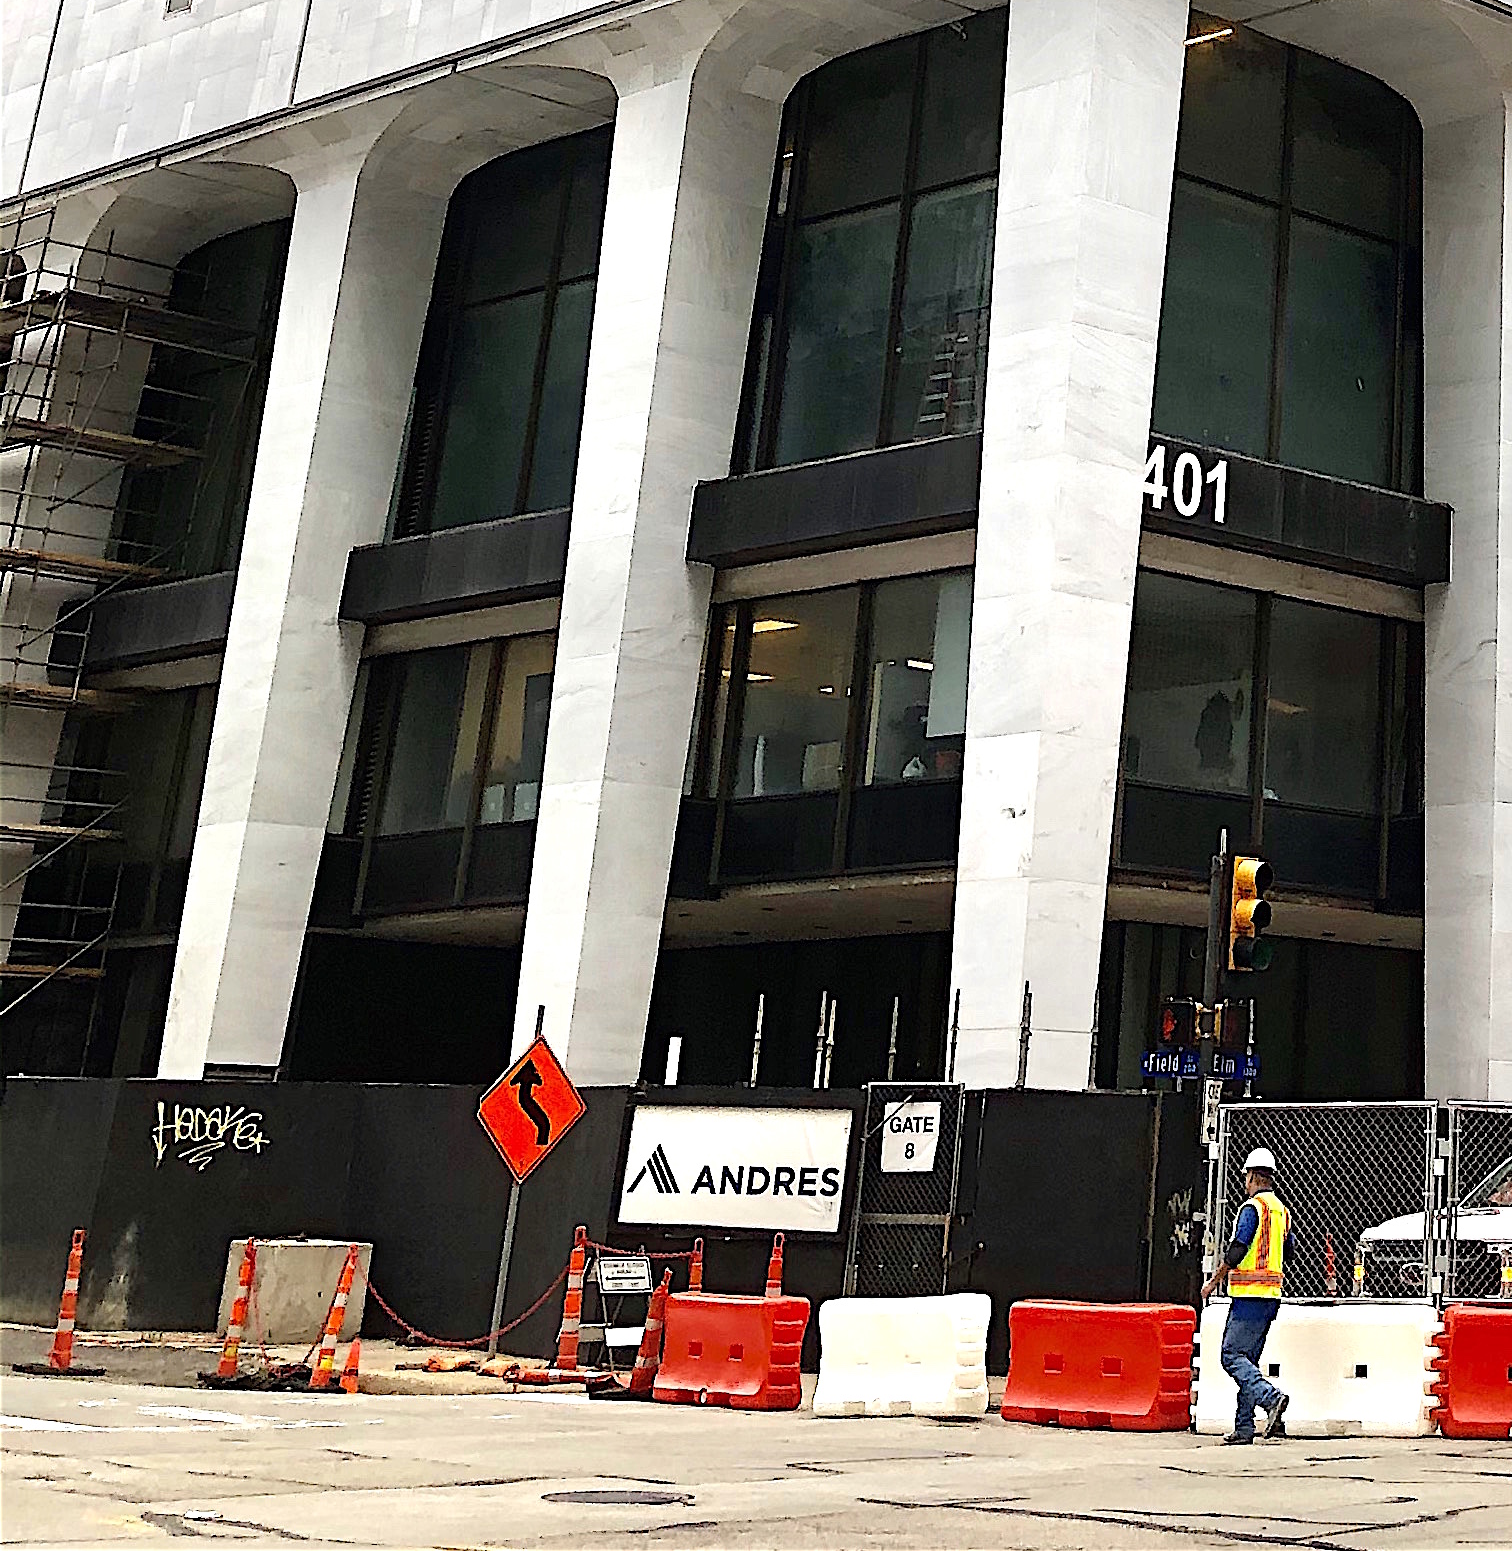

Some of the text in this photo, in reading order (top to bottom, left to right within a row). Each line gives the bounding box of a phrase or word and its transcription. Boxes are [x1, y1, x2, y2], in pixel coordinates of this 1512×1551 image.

[1148, 1053, 1179, 1073] Field
[1213, 1053, 1235, 1074] Elm
[889, 1116, 935, 1134] GATE
[904, 1142, 915, 1160] 8
[690, 1164, 840, 1198] ANDRES
